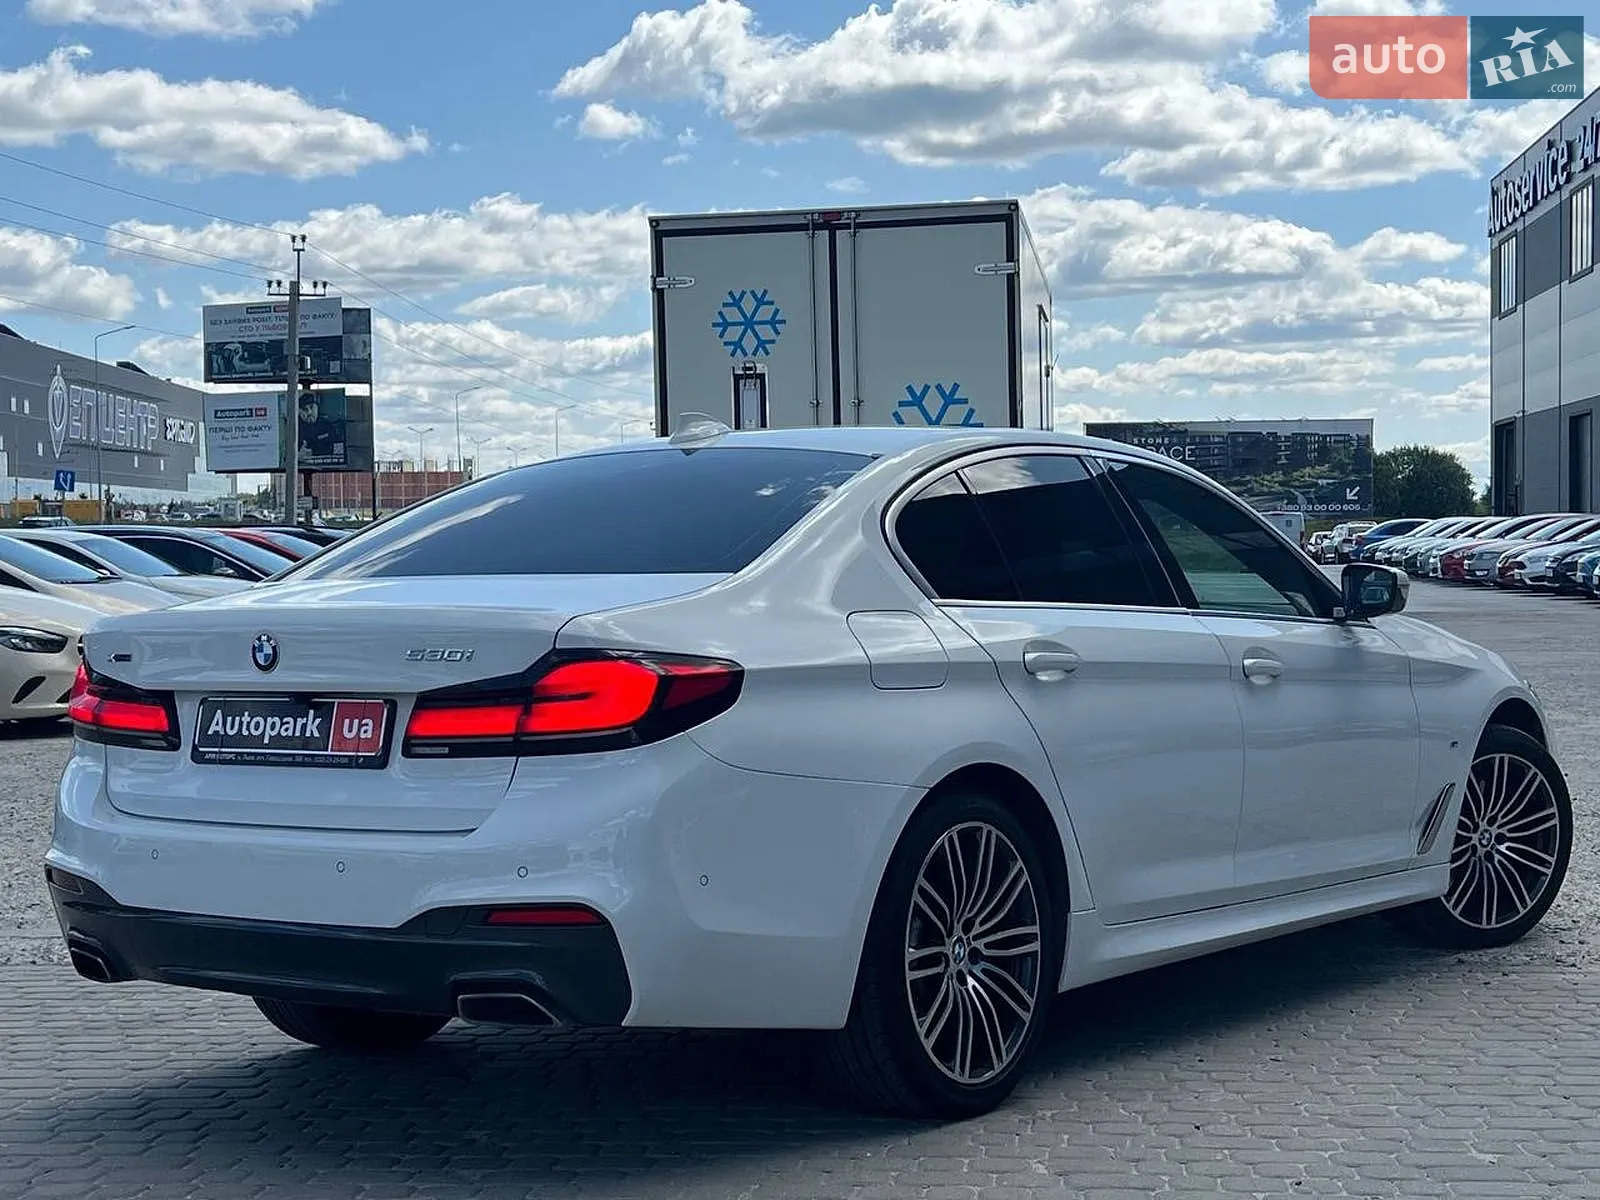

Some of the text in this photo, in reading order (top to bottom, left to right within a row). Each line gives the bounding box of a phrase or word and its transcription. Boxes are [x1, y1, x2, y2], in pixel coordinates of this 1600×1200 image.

[1487, 138, 1569, 234] Autoservice
[405, 648, 475, 662] 530i
[207, 709, 374, 744] Autopark ua
